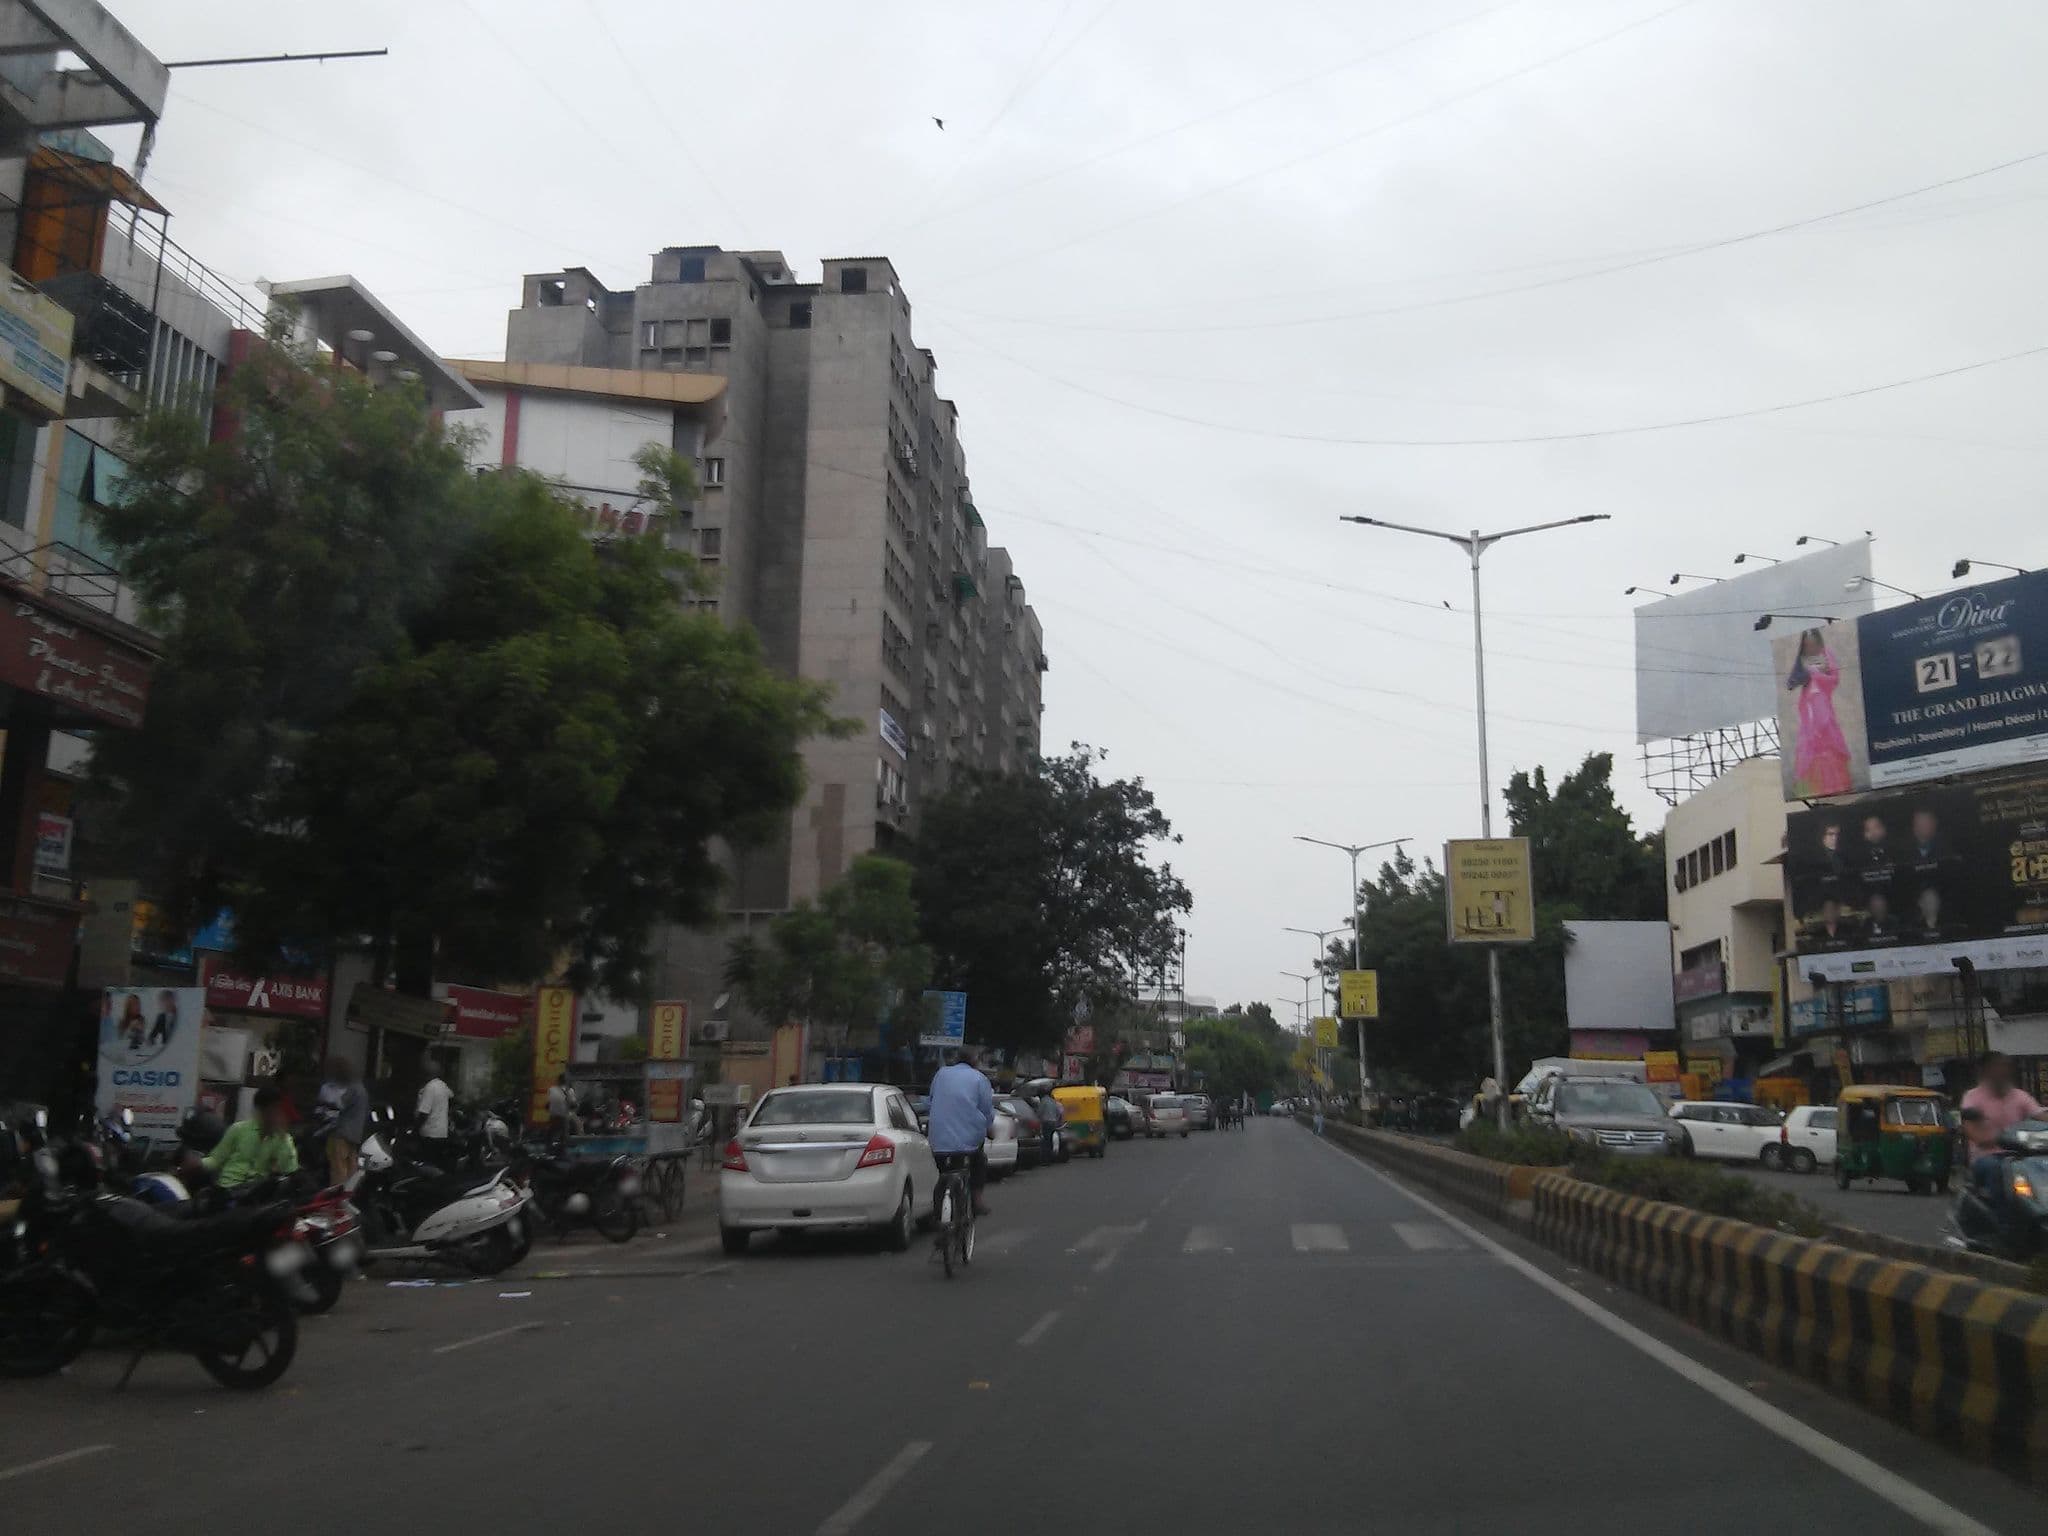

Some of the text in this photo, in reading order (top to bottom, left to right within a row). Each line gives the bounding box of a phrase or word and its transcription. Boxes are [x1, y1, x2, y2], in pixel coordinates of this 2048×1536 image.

[1922, 657, 1951, 685] 21
[1892, 708, 1922, 725] THE
[1924, 696, 1978, 719] GRAND
[271, 982, 322, 1002] AXIS BANK
[113, 1070, 181, 1087] CASIO
